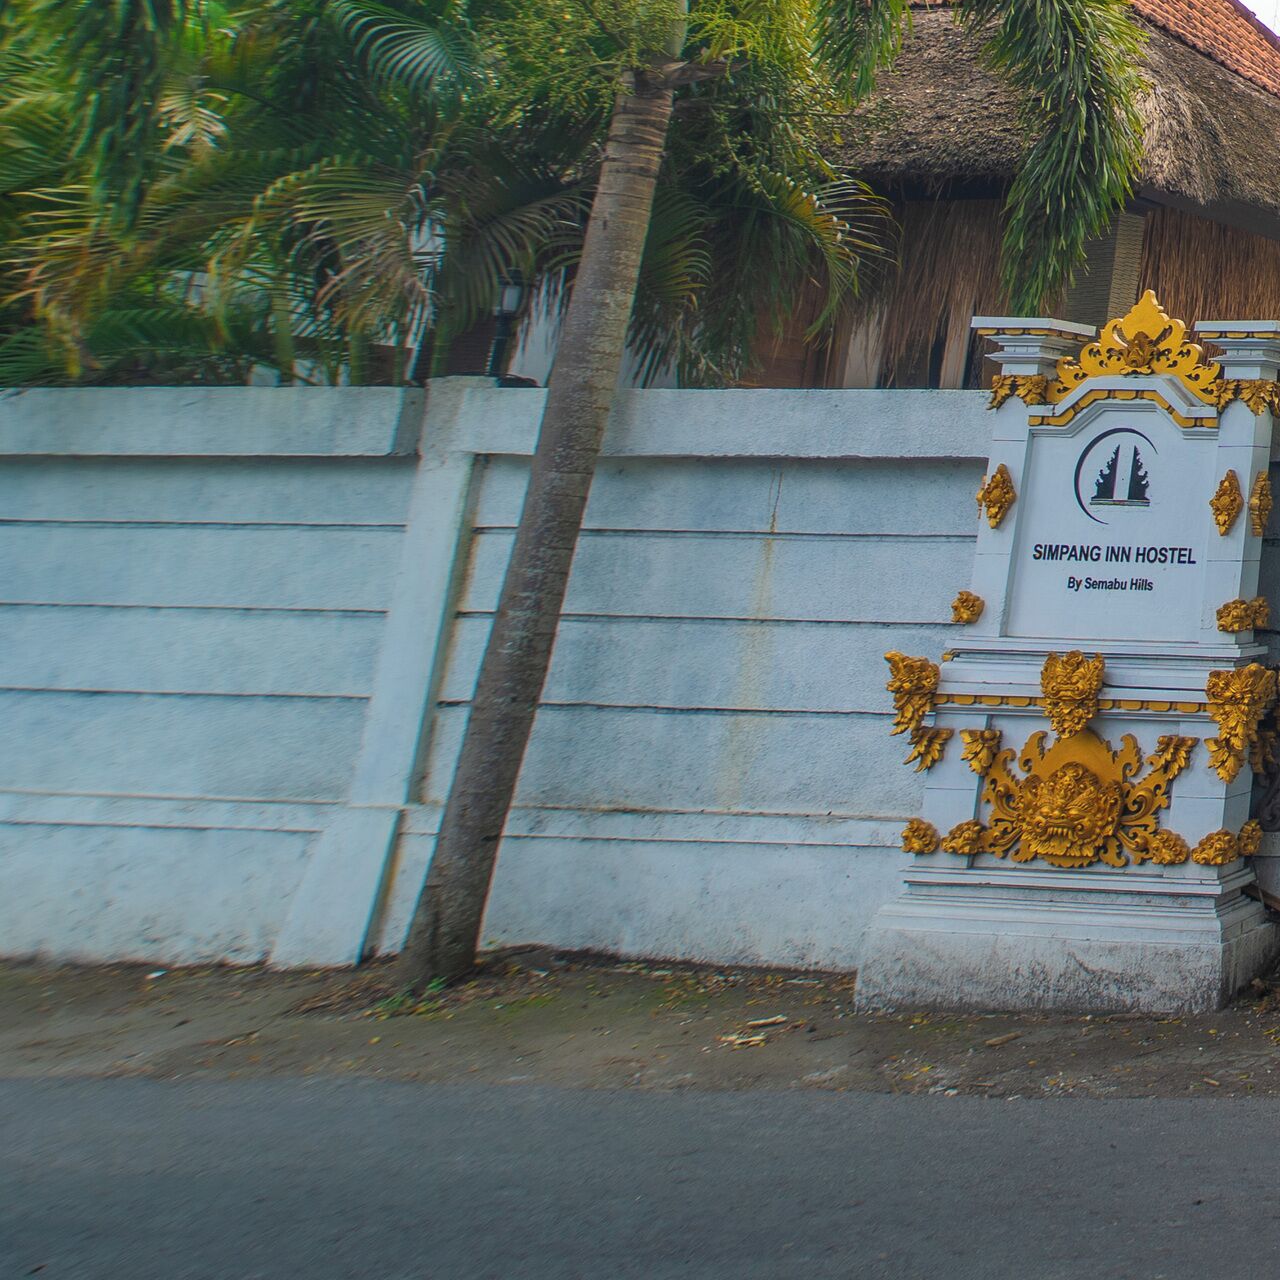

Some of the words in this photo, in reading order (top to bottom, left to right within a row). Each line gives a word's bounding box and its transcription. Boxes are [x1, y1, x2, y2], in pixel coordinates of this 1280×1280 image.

[1032, 543, 1101, 562] SIMPANG
[1105, 545, 1132, 563] INN
[1135, 546, 1196, 564] HOSTEL
[1067, 576, 1083, 592] By
[1084, 576, 1128, 591] Semabu
[1129, 577, 1154, 591] Hills
